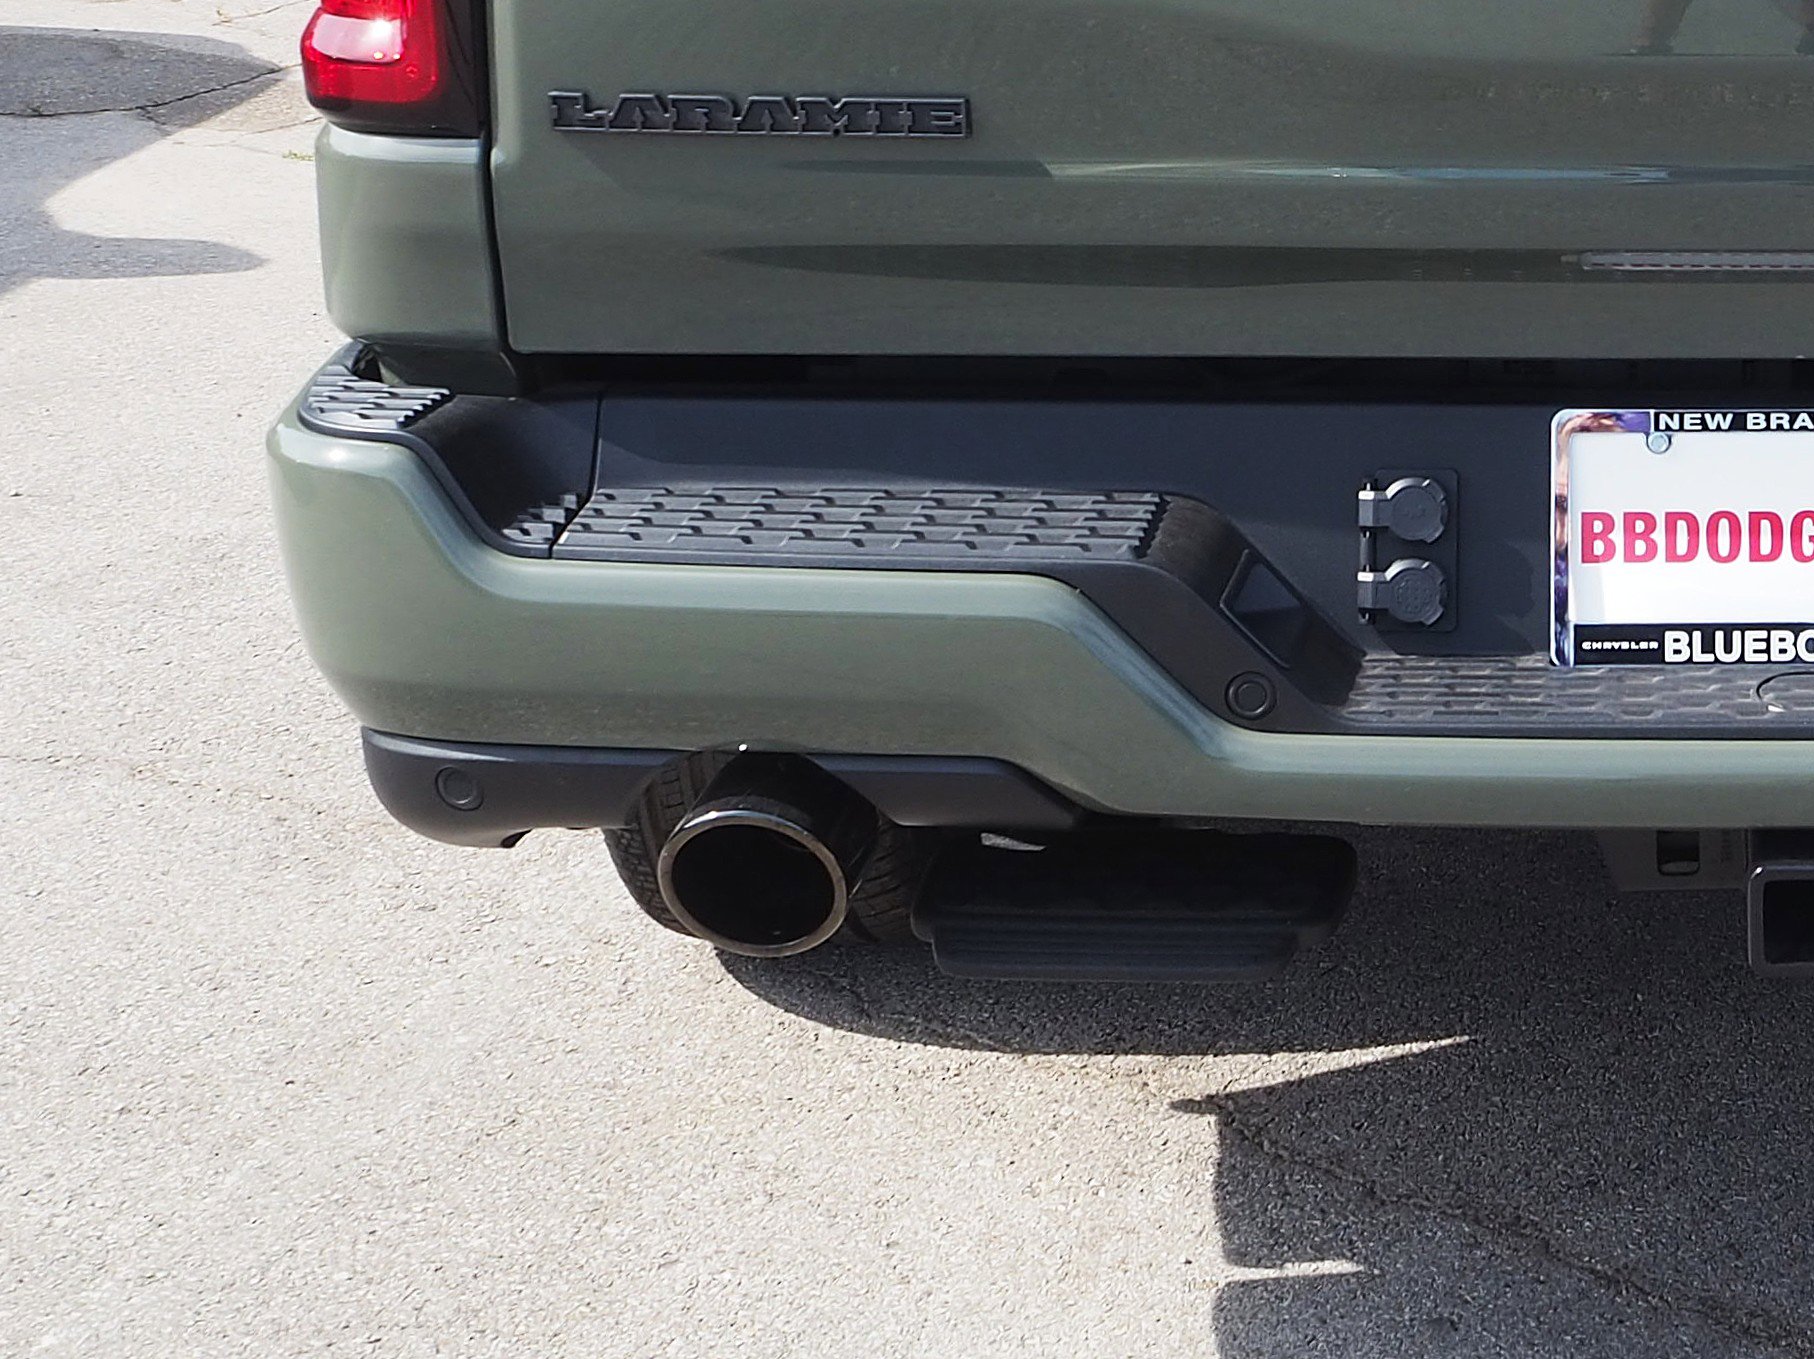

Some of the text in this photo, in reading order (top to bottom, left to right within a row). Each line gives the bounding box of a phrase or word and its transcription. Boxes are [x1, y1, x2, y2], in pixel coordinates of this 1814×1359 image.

[547, 90, 972, 138] LARAMIE
[1658, 413, 1734, 431] NEW
[1581, 641, 1659, 650] CHRYSLER
